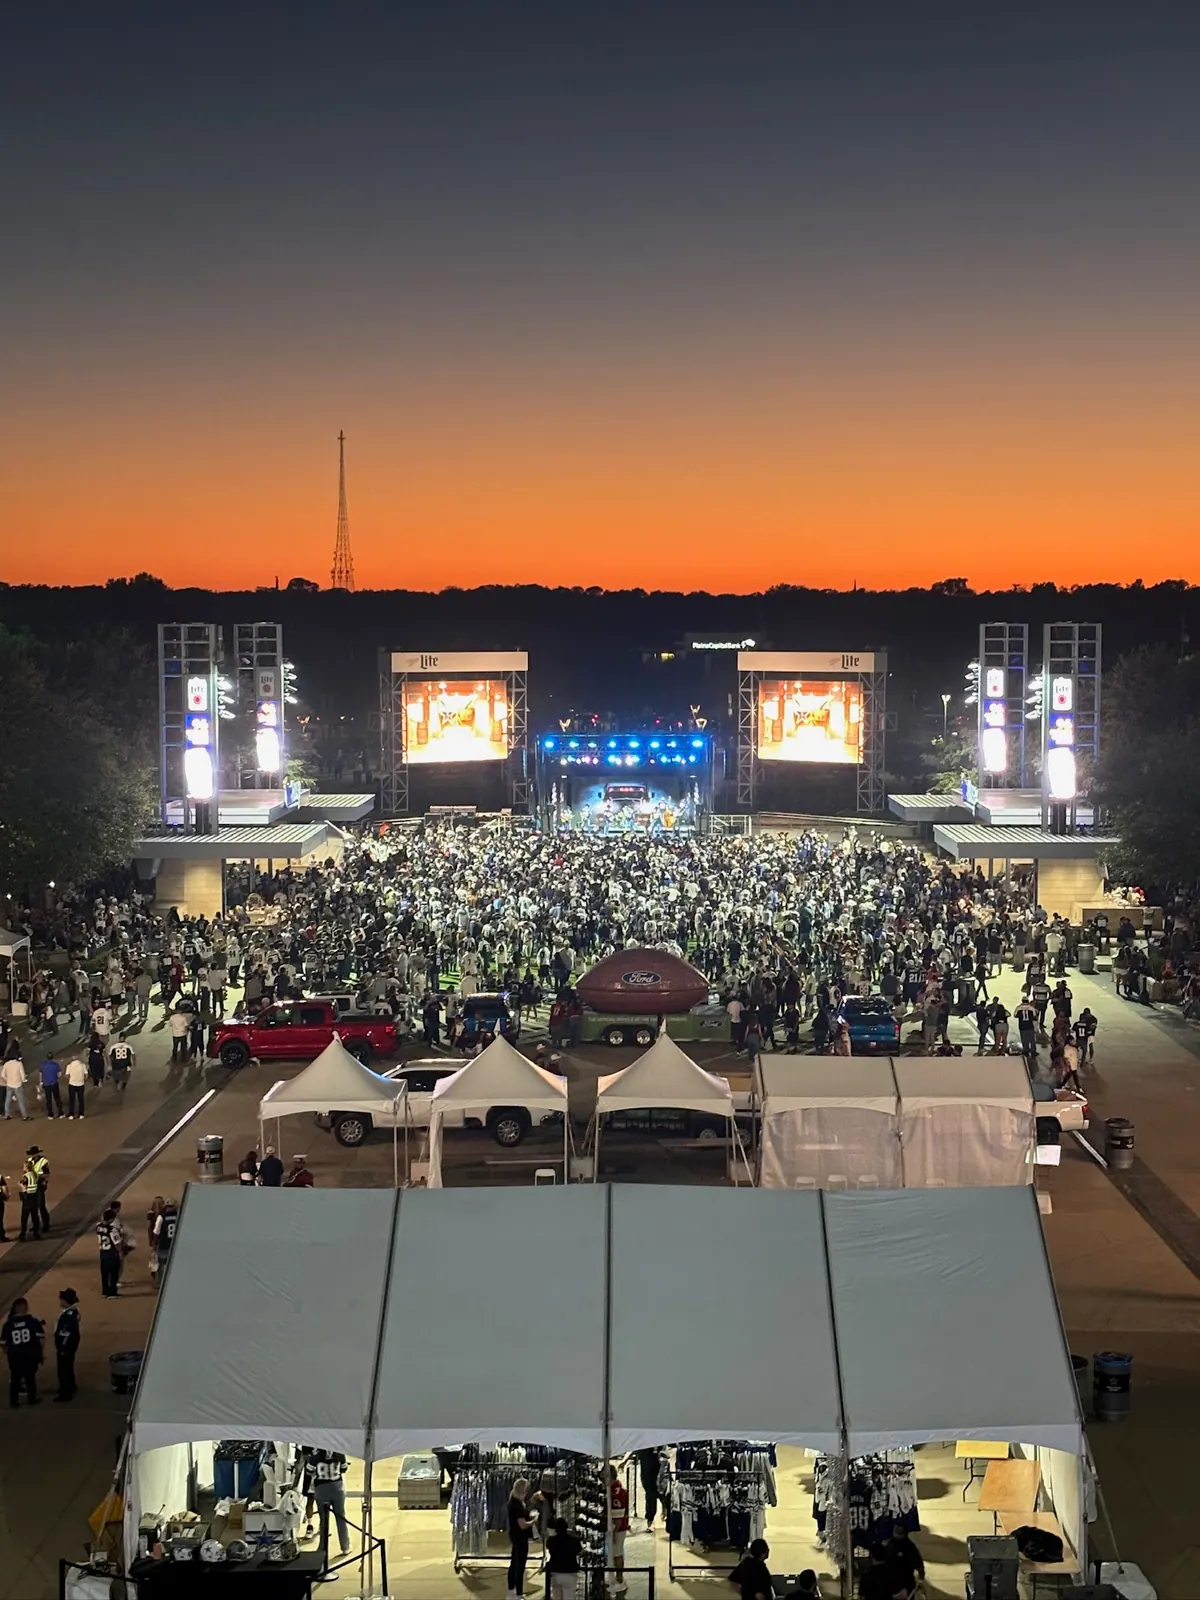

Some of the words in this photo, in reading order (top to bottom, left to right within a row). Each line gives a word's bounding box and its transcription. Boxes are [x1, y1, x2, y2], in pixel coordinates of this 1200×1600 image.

[420, 654, 438, 669] Lite
[841, 654, 860, 670] Lite
[629, 972, 654, 983] Ford
[97, 1015, 105, 1025] 21
[1022, 1009, 1030, 1021] 11
[115, 1048, 128, 1060] 88
[11, 1328, 31, 1345] 88
